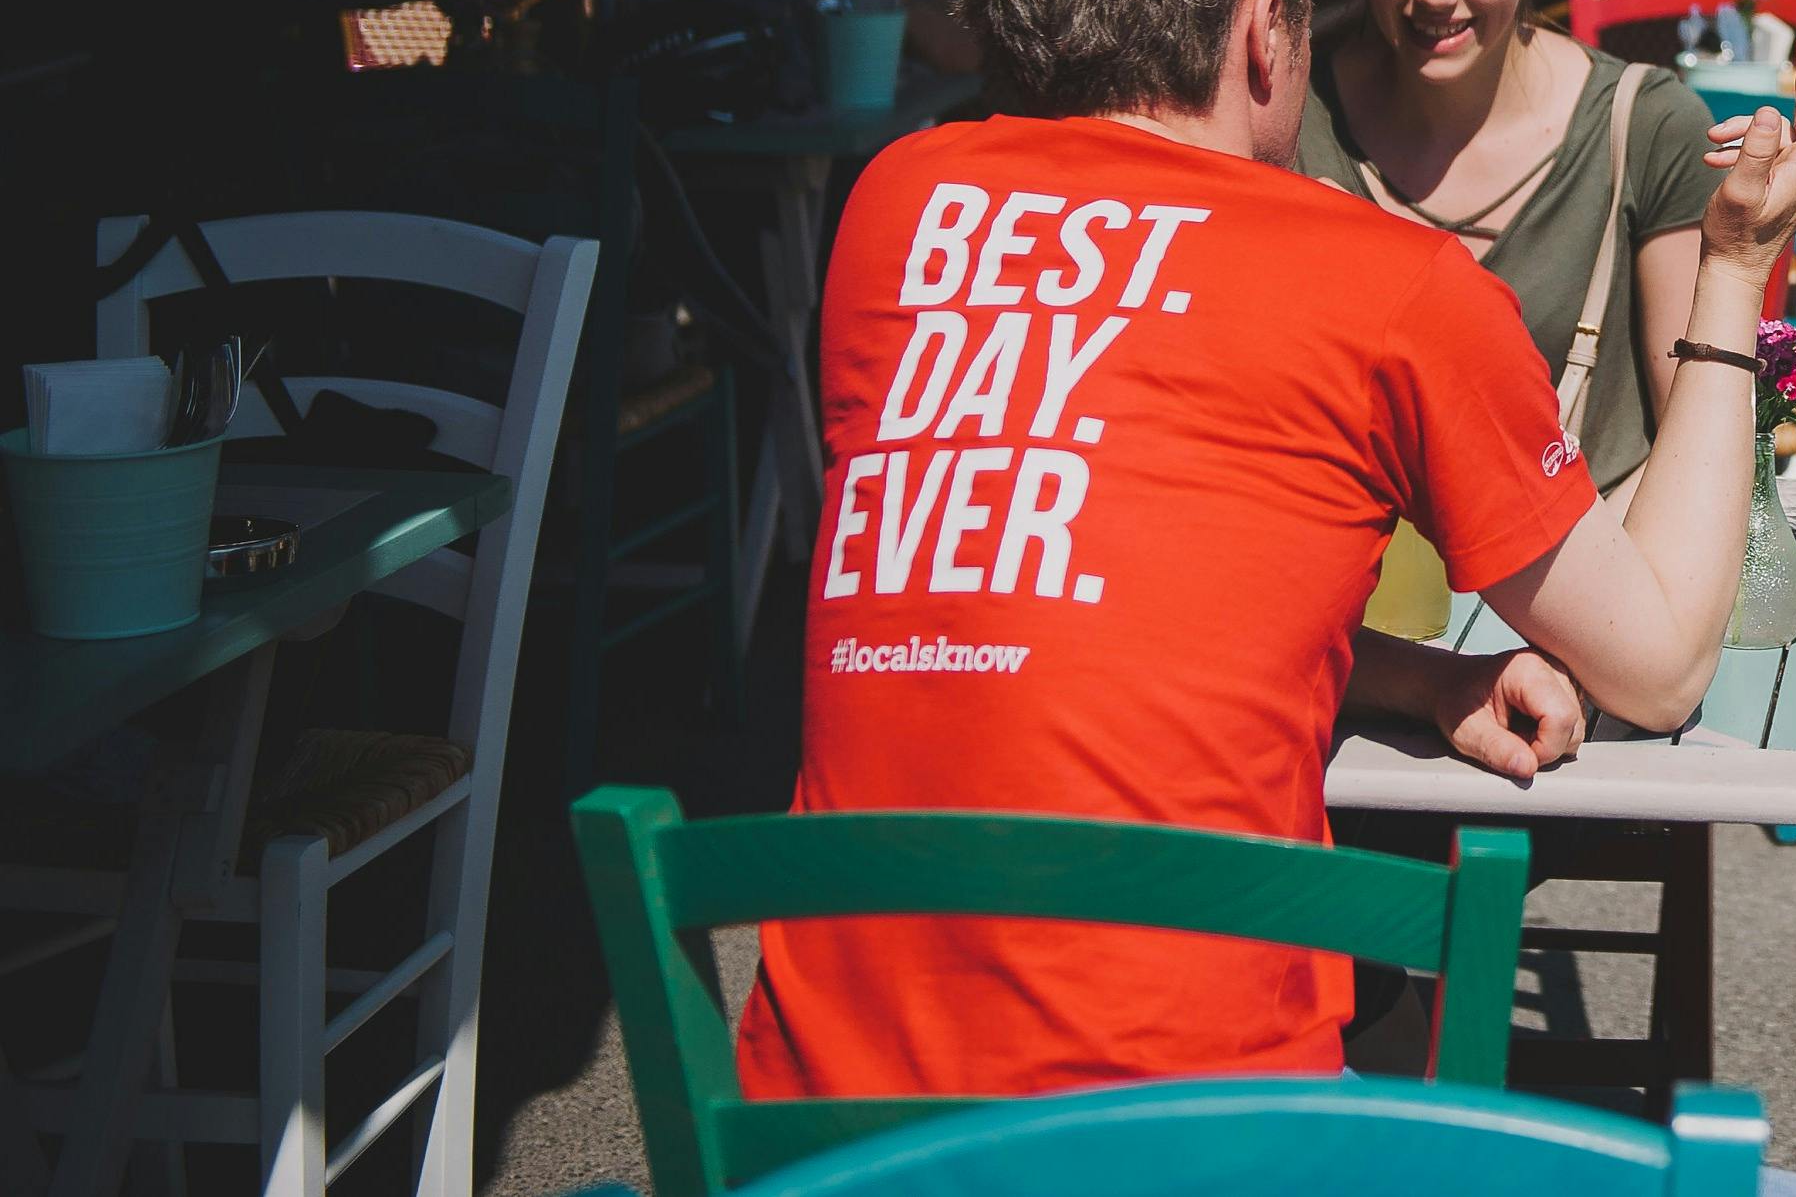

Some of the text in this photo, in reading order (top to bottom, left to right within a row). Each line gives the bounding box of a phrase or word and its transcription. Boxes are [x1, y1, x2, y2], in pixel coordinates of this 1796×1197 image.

[898, 182, 1212, 314] BEST.
[876, 310, 1131, 445] DAY.
[823, 446, 1105, 604] EVER.
[831, 634, 1031, 675] #localsknow
